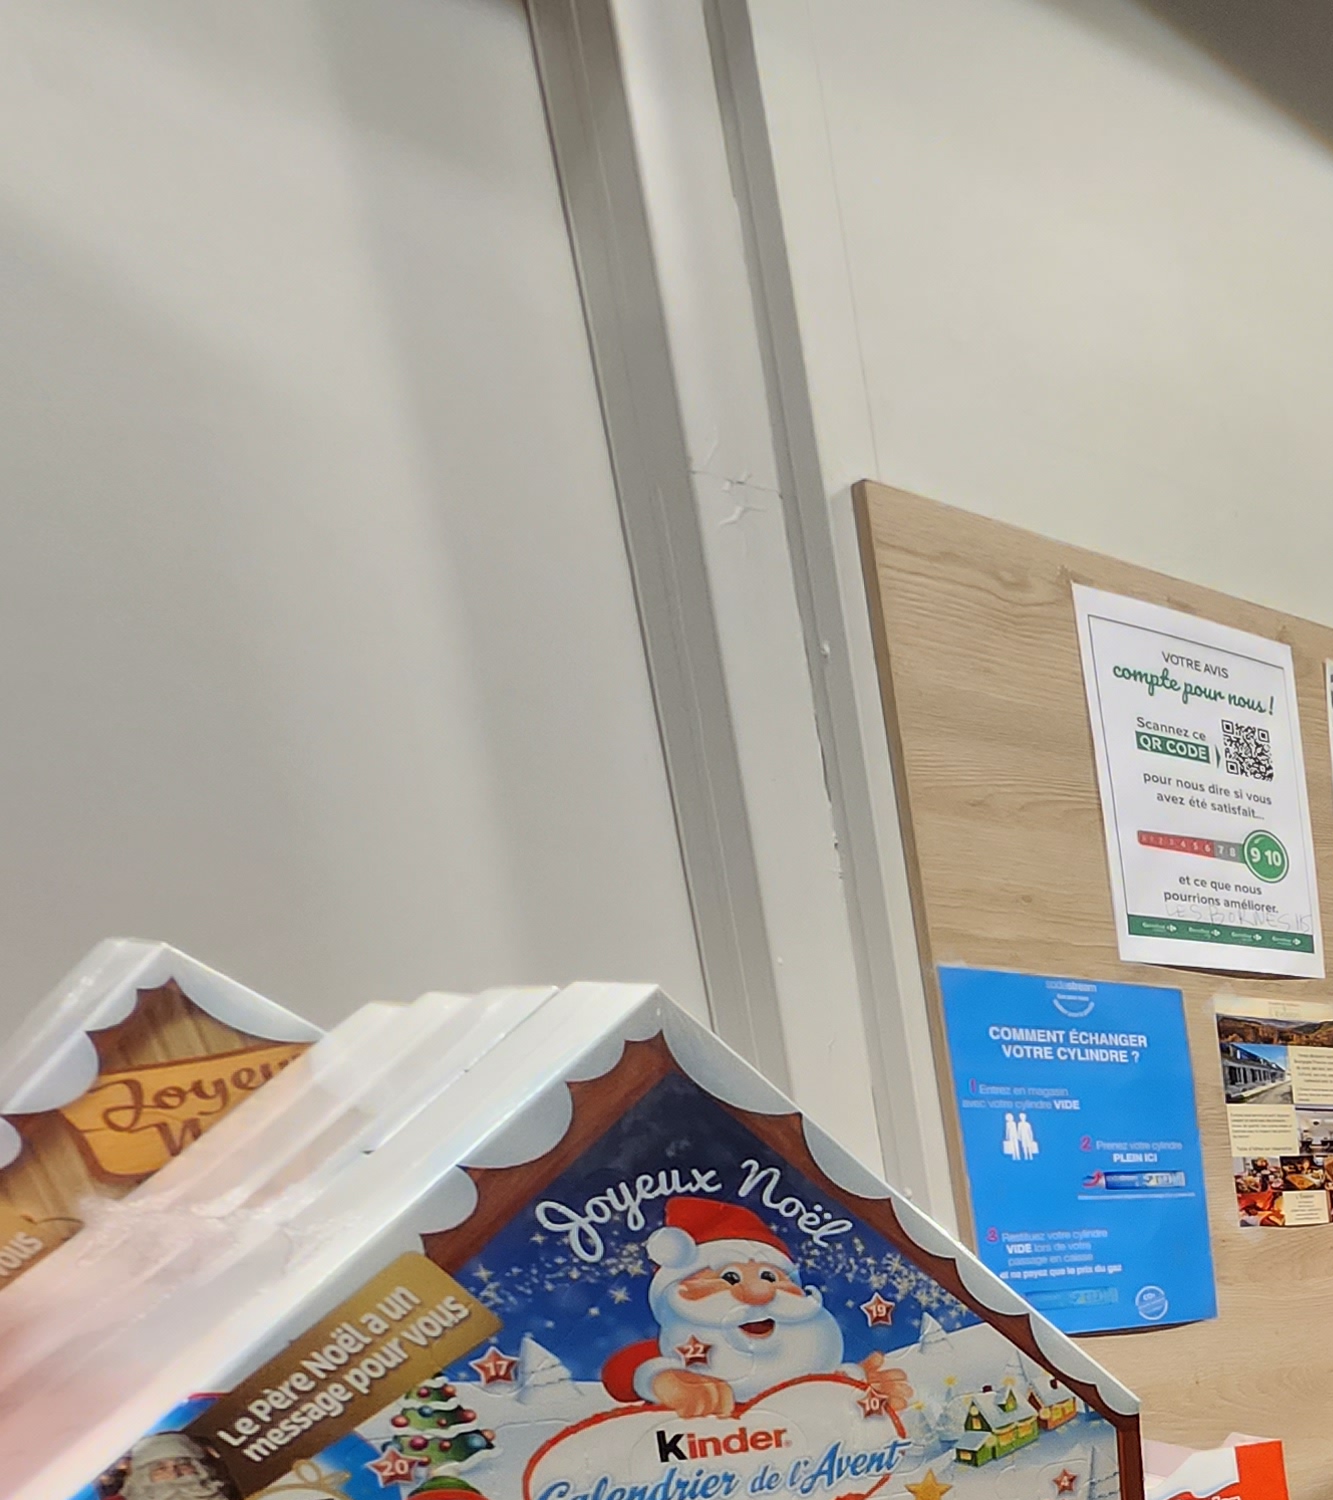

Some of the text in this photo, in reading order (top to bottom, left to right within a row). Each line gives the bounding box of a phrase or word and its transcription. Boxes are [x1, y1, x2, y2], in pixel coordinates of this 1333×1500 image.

[1162, 651, 1229, 679] VOTRE AVIS
[1112, 664, 1225, 705] compte pour
[1136, 716, 1206, 742] Scannez ce
[1139, 734, 1208, 761] QR CODE
[1143, 771, 1272, 805] pour nous dire si vous
[1157, 793, 1185, 806] avez
[1189, 796, 1207, 810] été
[1193, 842, 1198, 850] 5
[1205, 844, 1210, 852] 6
[1218, 845, 1224, 854] 7
[1229, 848, 1235, 857] 8
[1251, 847, 1261, 862] 9
[1265, 850, 1282, 866] 10
[1179, 876, 1262, 895] et ce que nous
[1164, 891, 1279, 913] pourrions améliorer.
[989, 1026, 1147, 1047] COMMENT ÉCHANGER
[1002, 1045, 1054, 1059] VOTRE
[1057, 1048, 1129, 1063] CYLINDRE
[1054, 1100, 1080, 1110] VIDE
[1113, 1153, 1157, 1162] PLEIN ICI
[534, 1159, 853, 1264] Joyeux Noël
[1006, 1244, 1032, 1254] VIDE
[870, 1303, 887, 1317] 19
[685, 1344, 705, 1359] 22
[216, 1285, 422, 1447] Le Père Noël a un
[488, 1360, 507, 1377] 17
[242, 1296, 470, 1463] message pour vous
[862, 1396, 881, 1412] 10
[655, 1425, 789, 1464] Kinder
[382, 1459, 409, 1476] 20
[750, 1471, 782, 1493] de
[788, 1439, 909, 1496] l'Avent
[1059, 1477, 1071, 1490] 4
